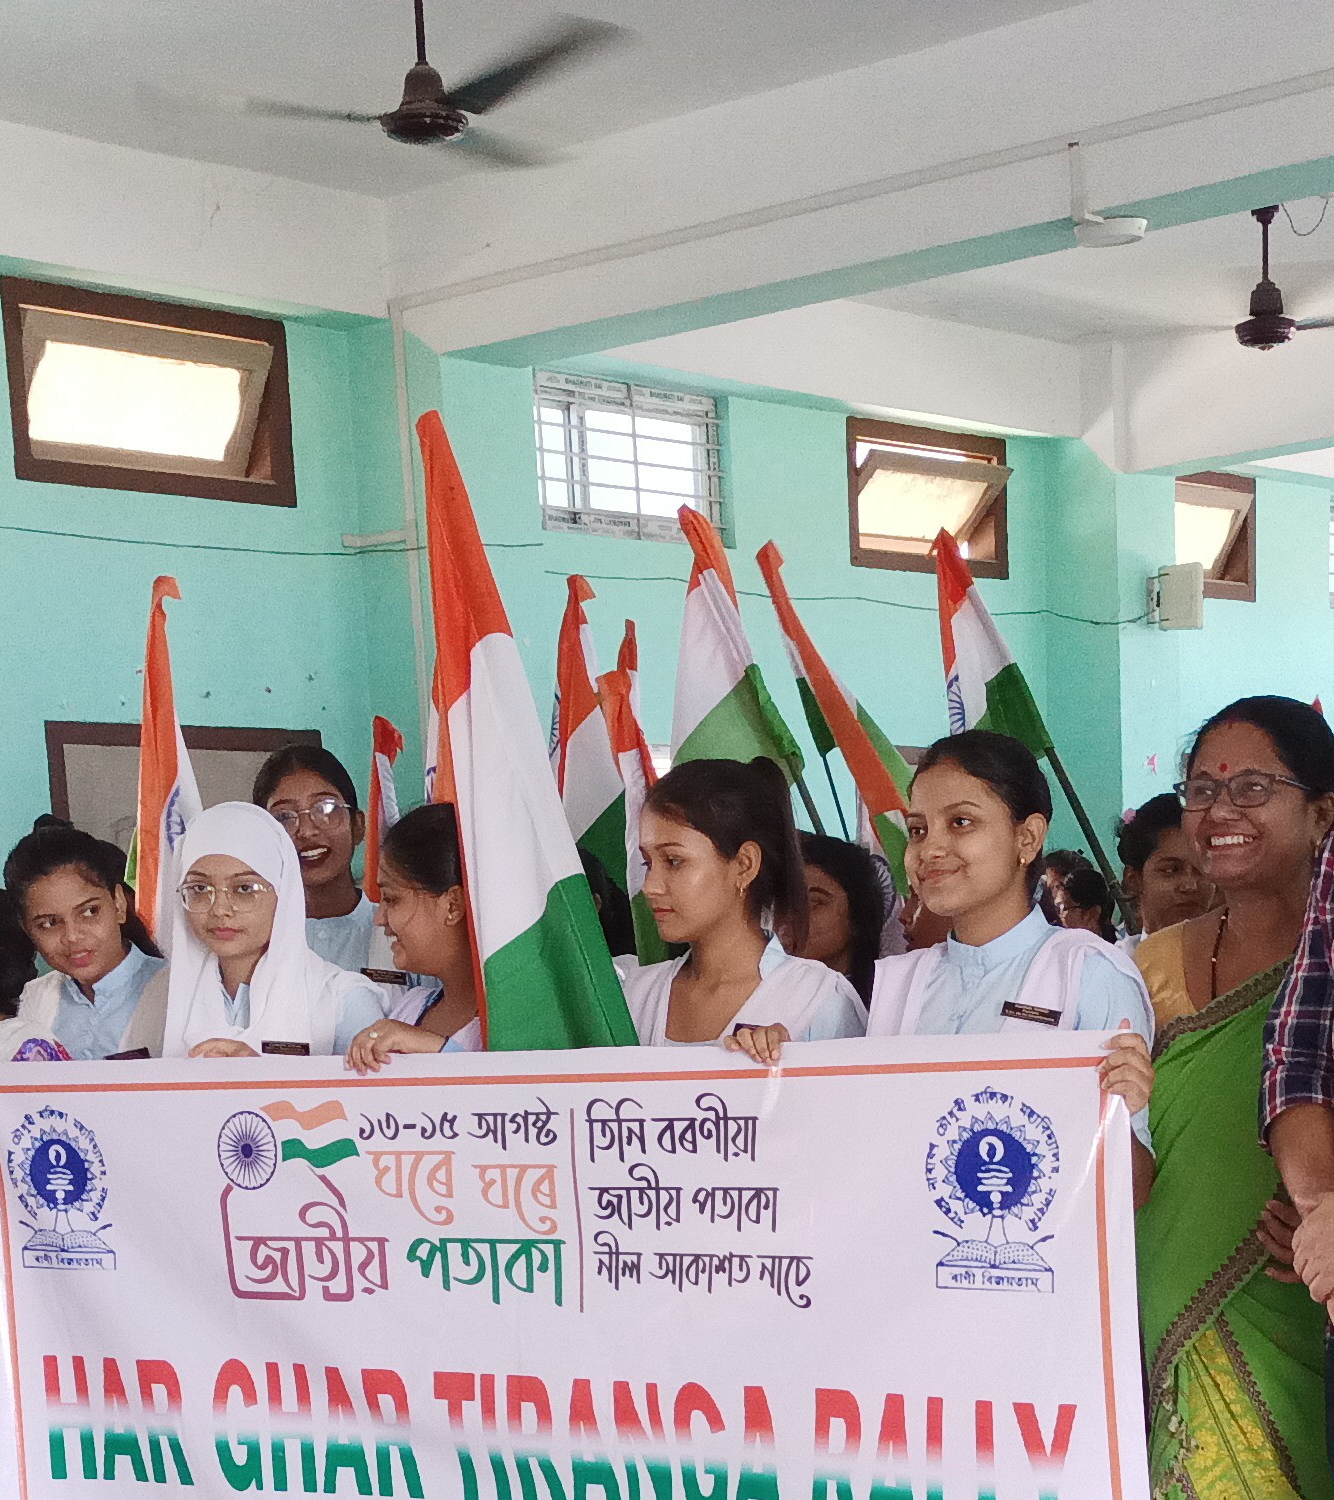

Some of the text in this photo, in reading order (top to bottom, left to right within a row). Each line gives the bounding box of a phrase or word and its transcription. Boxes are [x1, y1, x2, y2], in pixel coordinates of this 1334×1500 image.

[358, 1111, 459, 1141] ১৩-১৫
[585, 1092, 759, 1163] তিনি বৰণীয়া
[365, 1150, 558, 1236] ঘৰে ঘৰে
[587, 1162, 780, 1233] জাতীয় পতাকা
[231, 1200, 566, 1307] জাতীয় পতাকা
[592, 1230, 814, 1309] নীল আকাশত নাচে
[43, 1354, 195, 1486] HAR
[212, 1357, 425, 1500] GHAR
